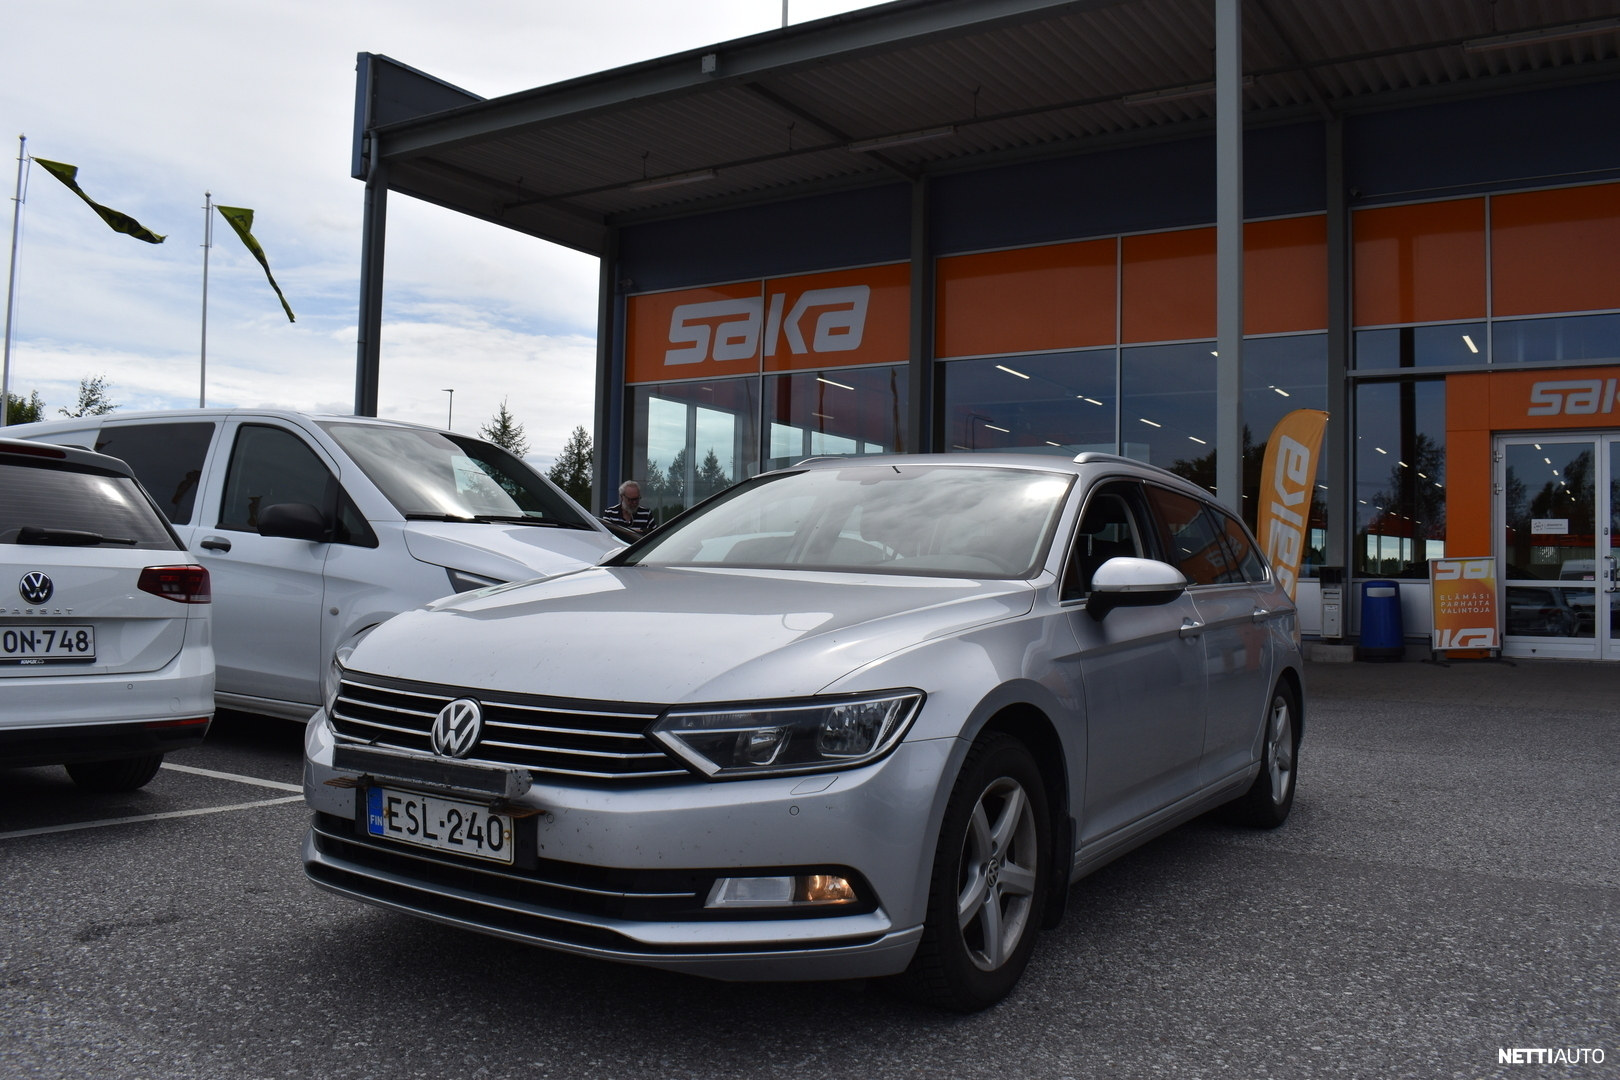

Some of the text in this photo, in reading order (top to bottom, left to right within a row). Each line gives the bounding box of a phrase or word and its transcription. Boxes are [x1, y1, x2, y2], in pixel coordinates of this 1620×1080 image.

[1439, 592, 1491, 601] ELÄMÄSI
[1440, 600, 1491, 608] PARHAITA
[1440, 607, 1491, 615] VALINTOJA
[370, 796, 504, 853] FIN ESL-240
